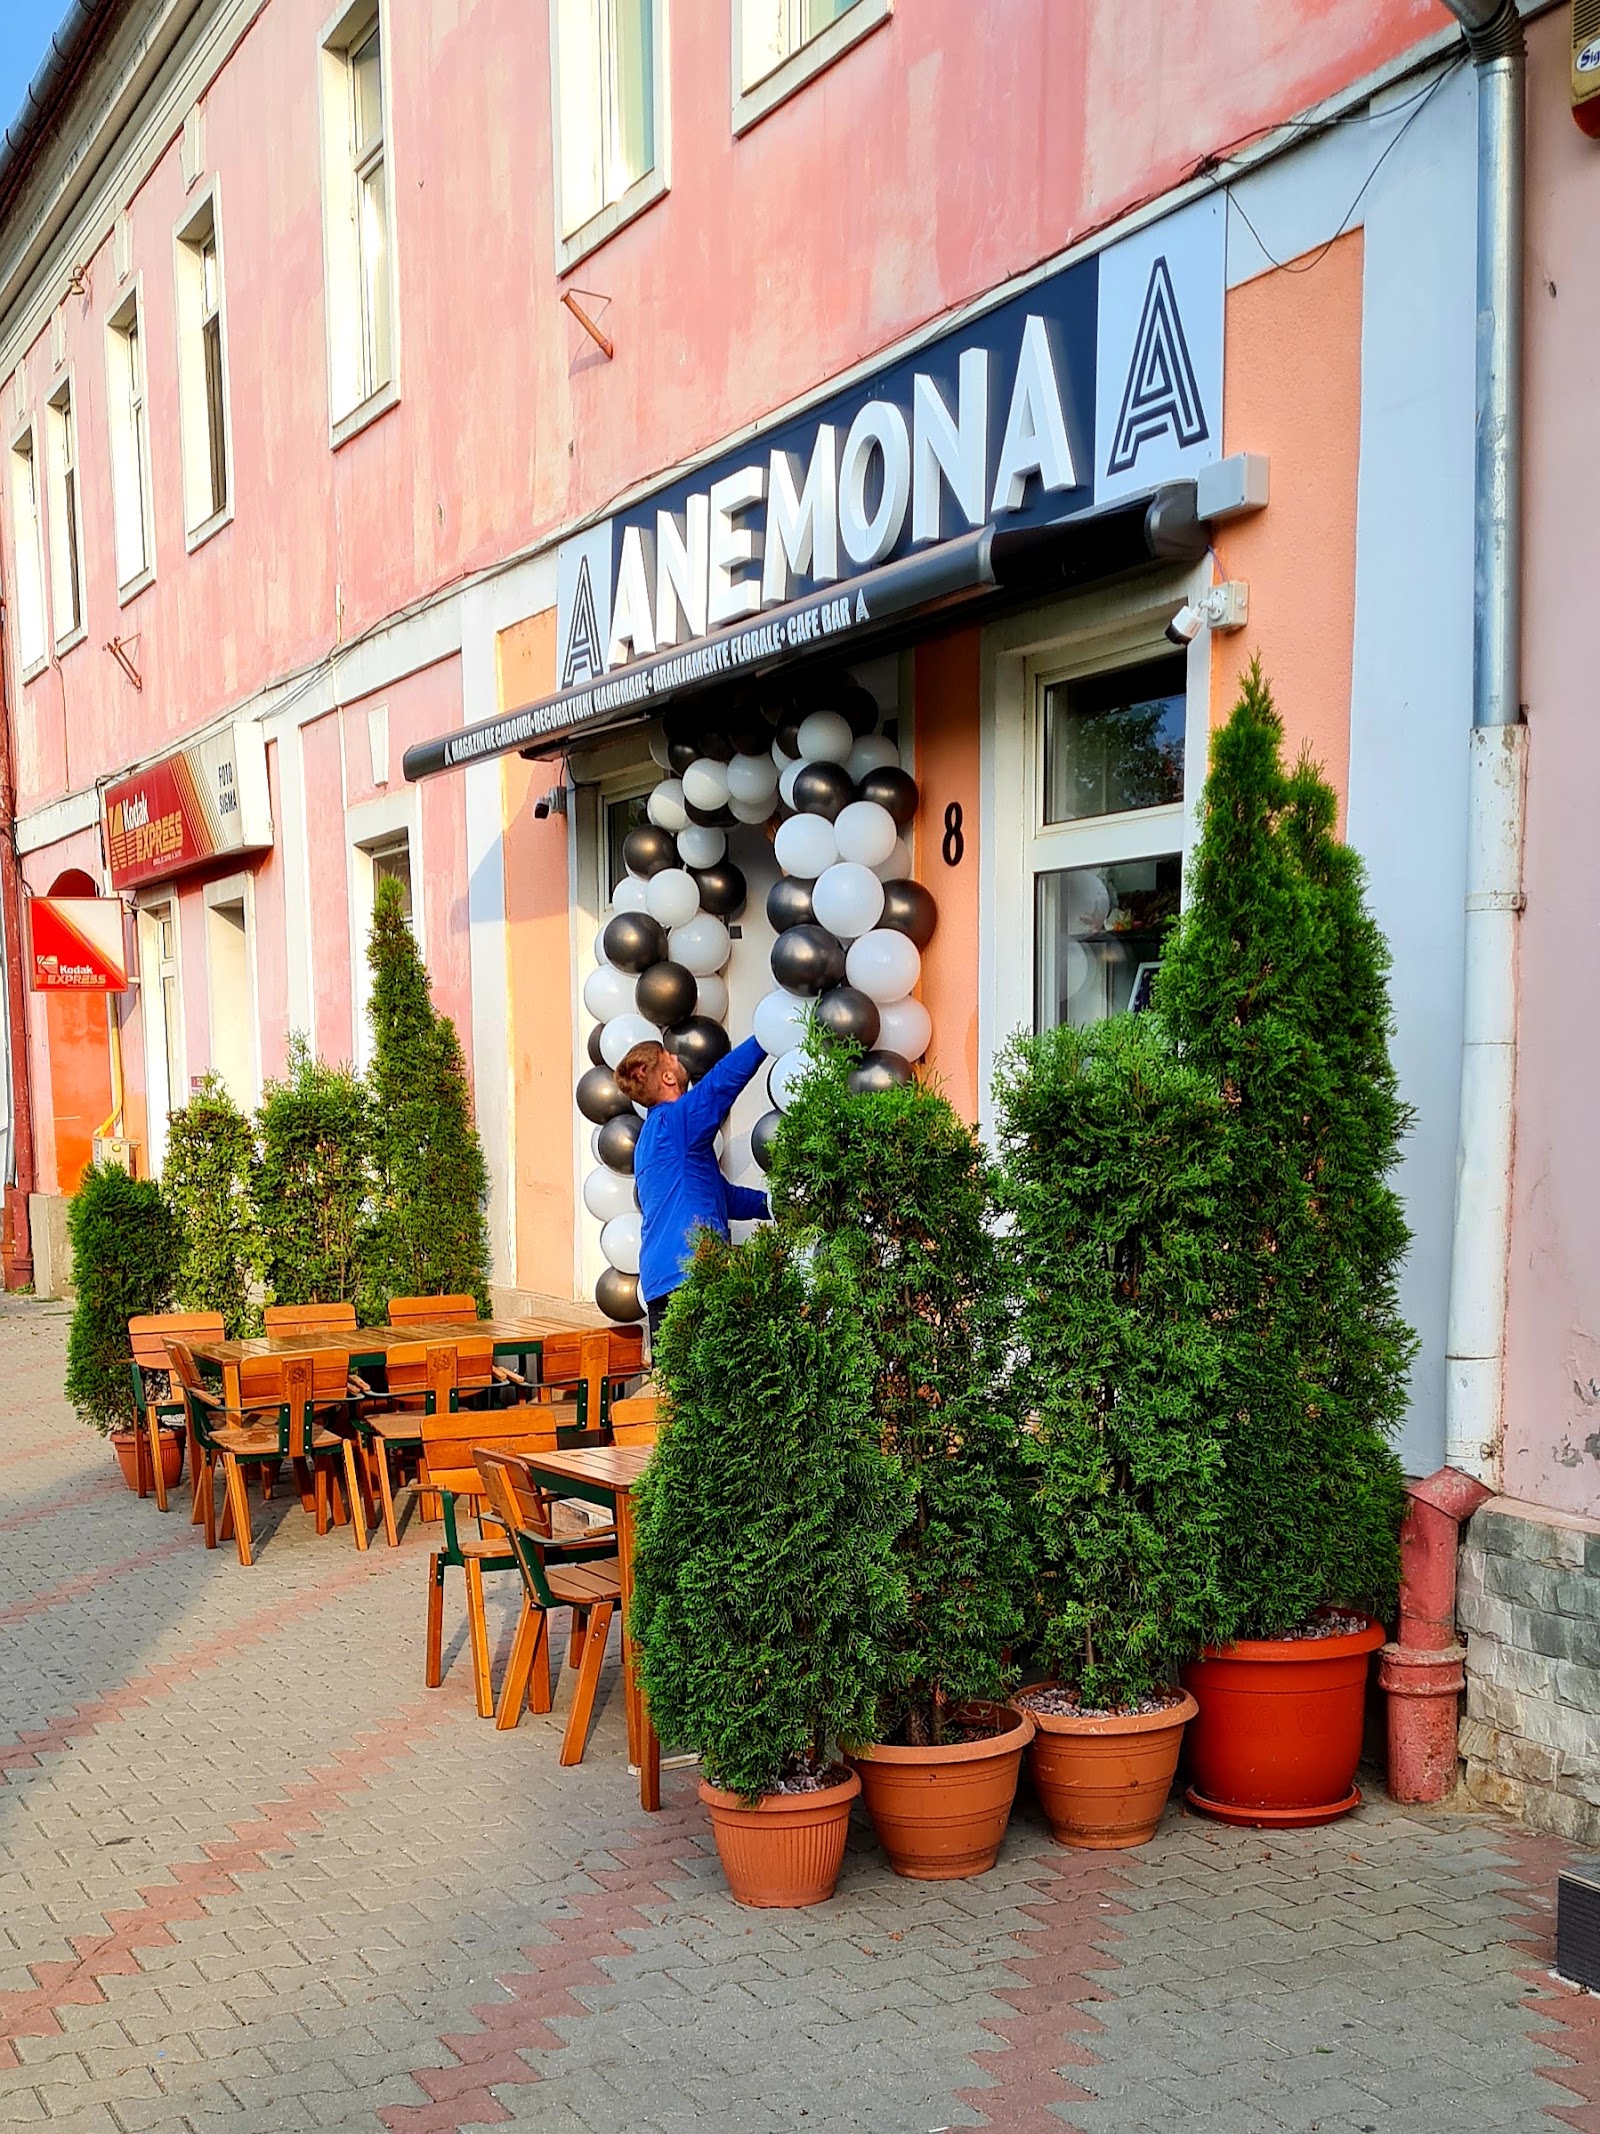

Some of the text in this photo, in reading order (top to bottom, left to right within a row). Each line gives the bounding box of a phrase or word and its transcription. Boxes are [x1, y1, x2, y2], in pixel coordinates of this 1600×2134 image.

[562, 255, 1209, 688] A ANEMONA A
[451, 732, 486, 761] MAGAZIN
[485, 730, 497, 749] DE
[788, 607, 821, 645] CAFE
[821, 597, 852, 634] BAR
[219, 762, 232, 787] FOTO
[123, 790, 149, 832] Kodak
[942, 802, 964, 867] 8
[136, 810, 183, 863] EXPRESS
[47, 974, 106, 984] EXPRESS
[60, 964, 93, 975] Kodak
